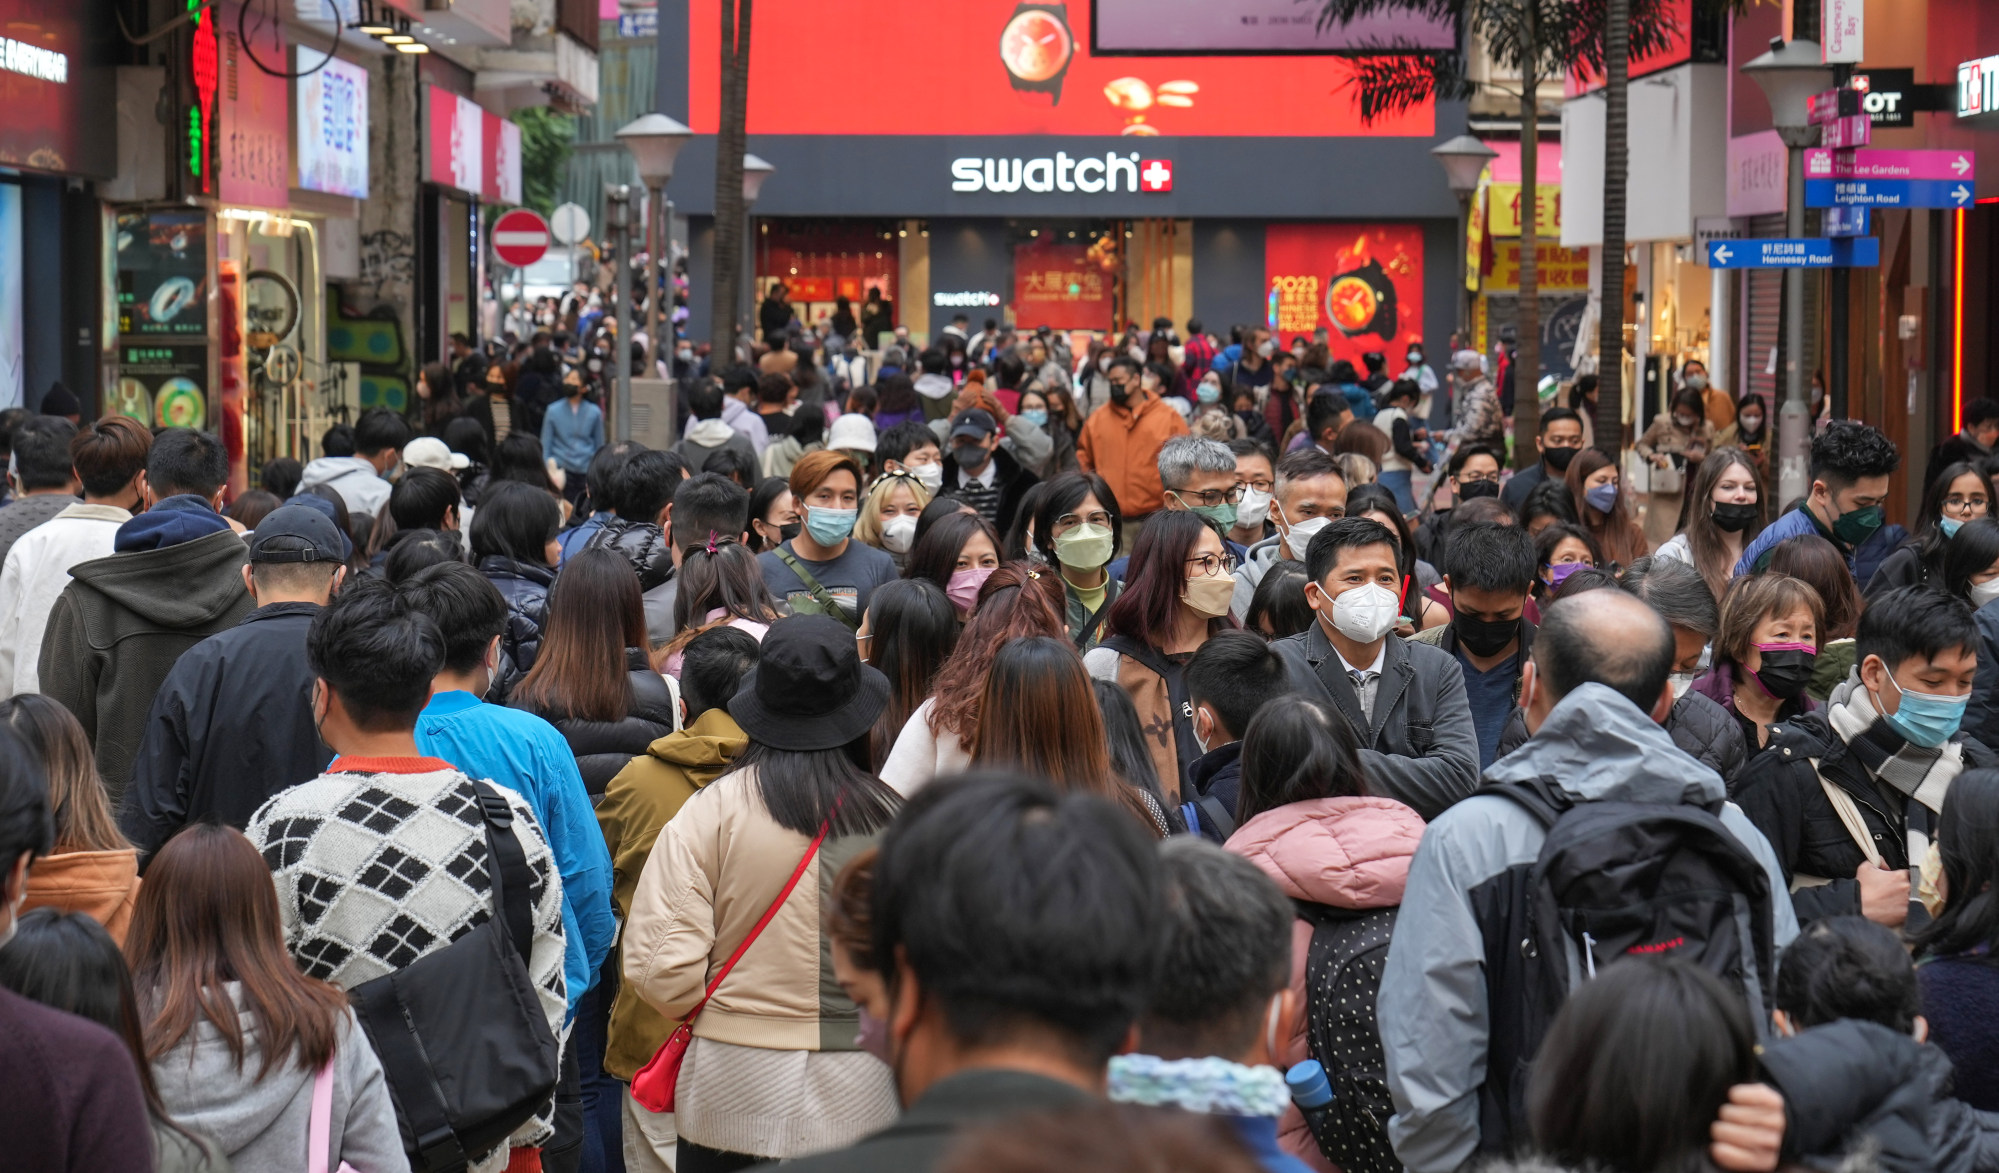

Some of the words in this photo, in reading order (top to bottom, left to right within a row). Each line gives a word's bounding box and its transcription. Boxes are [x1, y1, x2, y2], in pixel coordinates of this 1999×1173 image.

[1845, 15, 1859, 36] Bay
[951, 151, 1140, 193] swatch
[1835, 165, 1852, 174] The
[1854, 165, 1870, 174] Lee
[1872, 165, 1910, 175] Gardens
[1835, 194, 1874, 204] Leighton
[1876, 194, 1900, 203] Road
[1762, 243, 1805, 255] 軒尼詩道
[1762, 255, 1807, 265] Hennessy
[1809, 254, 1833, 264] Road
[1272, 275, 1318, 293] 2023
[934, 291, 991, 306] swatch
[1278, 321, 1316, 332] PECIAL
